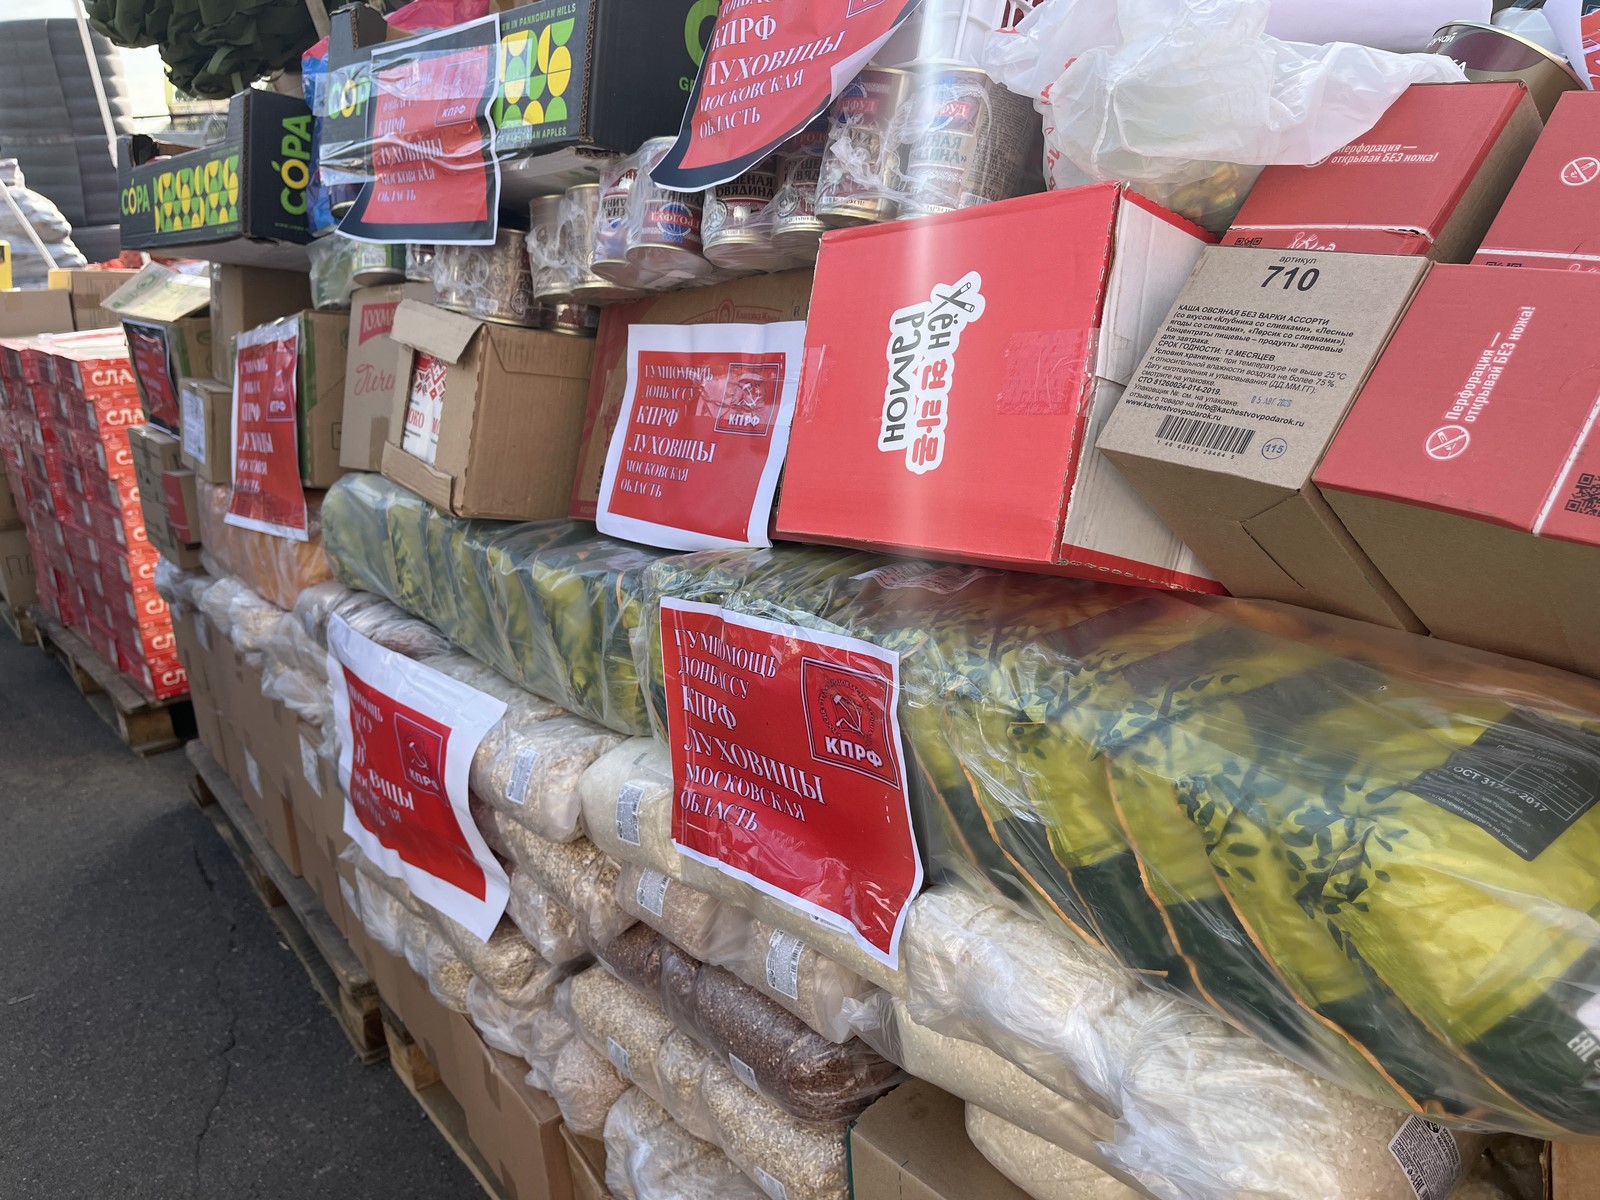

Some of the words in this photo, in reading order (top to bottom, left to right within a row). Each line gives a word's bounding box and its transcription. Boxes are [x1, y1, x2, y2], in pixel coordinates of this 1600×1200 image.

[511, 20, 518, 28] IN
[556, 4, 576, 16] HILLS
[712, 15, 777, 51] КПРФ
[703, 30, 846, 88] ЛУХОВИЦЫ
[329, 66, 371, 119] CÓP
[700, 68, 804, 114] МОСКОВСКАЯ
[442, 104, 466, 118] КПРФ
[700, 106, 761, 140] ОБЛАСТЬ
[542, 127, 566, 138] APPLES
[1331, 153, 1381, 165] открывай
[1382, 152, 1404, 162] БЕЗ
[1404, 152, 1440, 162] ножа!
[716, 184, 774, 198] ОВЯДИНА
[1278, 256, 1318, 264] артикул
[1260, 266, 1320, 291] 710
[1178, 304, 1200, 312] КАША
[1202, 306, 1240, 316] ОВСЯНАЯ
[1241, 310, 1258, 318] БЕЗ
[1258, 312, 1286, 321] ВАРКИ
[1287, 316, 1330, 326] АССОРТИ
[1186, 314, 1212, 322] вкусом
[1214, 316, 1254, 325] «Клубника
[1266, 322, 1312, 334] сливками»,
[1316, 327, 1354, 337] «Лесные
[1166, 326, 1212, 338] Концентраты
[1214, 332, 1250, 342] пищевые
[1258, 338, 1299, 348] продукты
[1300, 343, 1344, 354] зерновые
[1170, 320, 1192, 328] ягоды
[1204, 322, 1246, 334] сливками»,
[1248, 328, 1281, 337] «Персик
[1176, 336, 1210, 344] завтрака.
[1158, 340, 1178, 348] СРОК
[1179, 342, 1222, 354] ГОДНОСТИ:
[1224, 348, 1234, 356] 12
[1145, 362, 1162, 370] Дату
[1162, 365, 1208, 376] изготовления
[1214, 372, 1268, 386] упаковывания
[1154, 347, 1183, 356] Условия
[1184, 353, 1221, 362] хранения:
[1238, 360, 1286, 372] температуре
[1300, 368, 1323, 377] выше
[1156, 356, 1206, 368] относительной
[1206, 364, 1244, 374] влажности
[1246, 369, 1277, 379] воздуха
[1288, 374, 1314, 385] более
[1464, 366, 1504, 423] открывай
[1493, 342, 1516, 364] БЕЗ
[1508, 306, 1536, 340] ножа!
[1138, 376, 1152, 384] СТО
[1142, 370, 1172, 380] смотрите
[1182, 376, 1216, 386] упаковке.
[1444, 349, 1494, 420] Перфорация
[1134, 384, 1169, 395] Упаковщик
[1204, 396, 1238, 407] упаковке.
[636, 406, 680, 427] КПРФ
[728, 413, 760, 427] КПРФ
[1125, 398, 1222, 421] www.kachestvovpodarok.ru
[1130, 392, 1154, 400] отзывы
[1160, 396, 1184, 407] товаре
[1196, 402, 1305, 428] info@kachestvovpodarok.ru
[628, 434, 717, 463] ЛУХОВИЦЫ
[1266, 444, 1284, 454] 115
[626, 459, 688, 482] МОСКОВСКАЯ
[620, 478, 662, 498] ОБЛАСТЬ
[674, 628, 777, 680] ГУМПОМОЩЬ
[678, 656, 750, 699] ДОНБАССУ
[681, 684, 737, 730] КПРФ
[825, 736, 883, 768] КПРФ
[683, 726, 826, 806] ЛУХОВИЦЫ
[686, 762, 806, 822] МОСКОВСКАЯ
[680, 788, 759, 832] ОБЛАСТЬ
